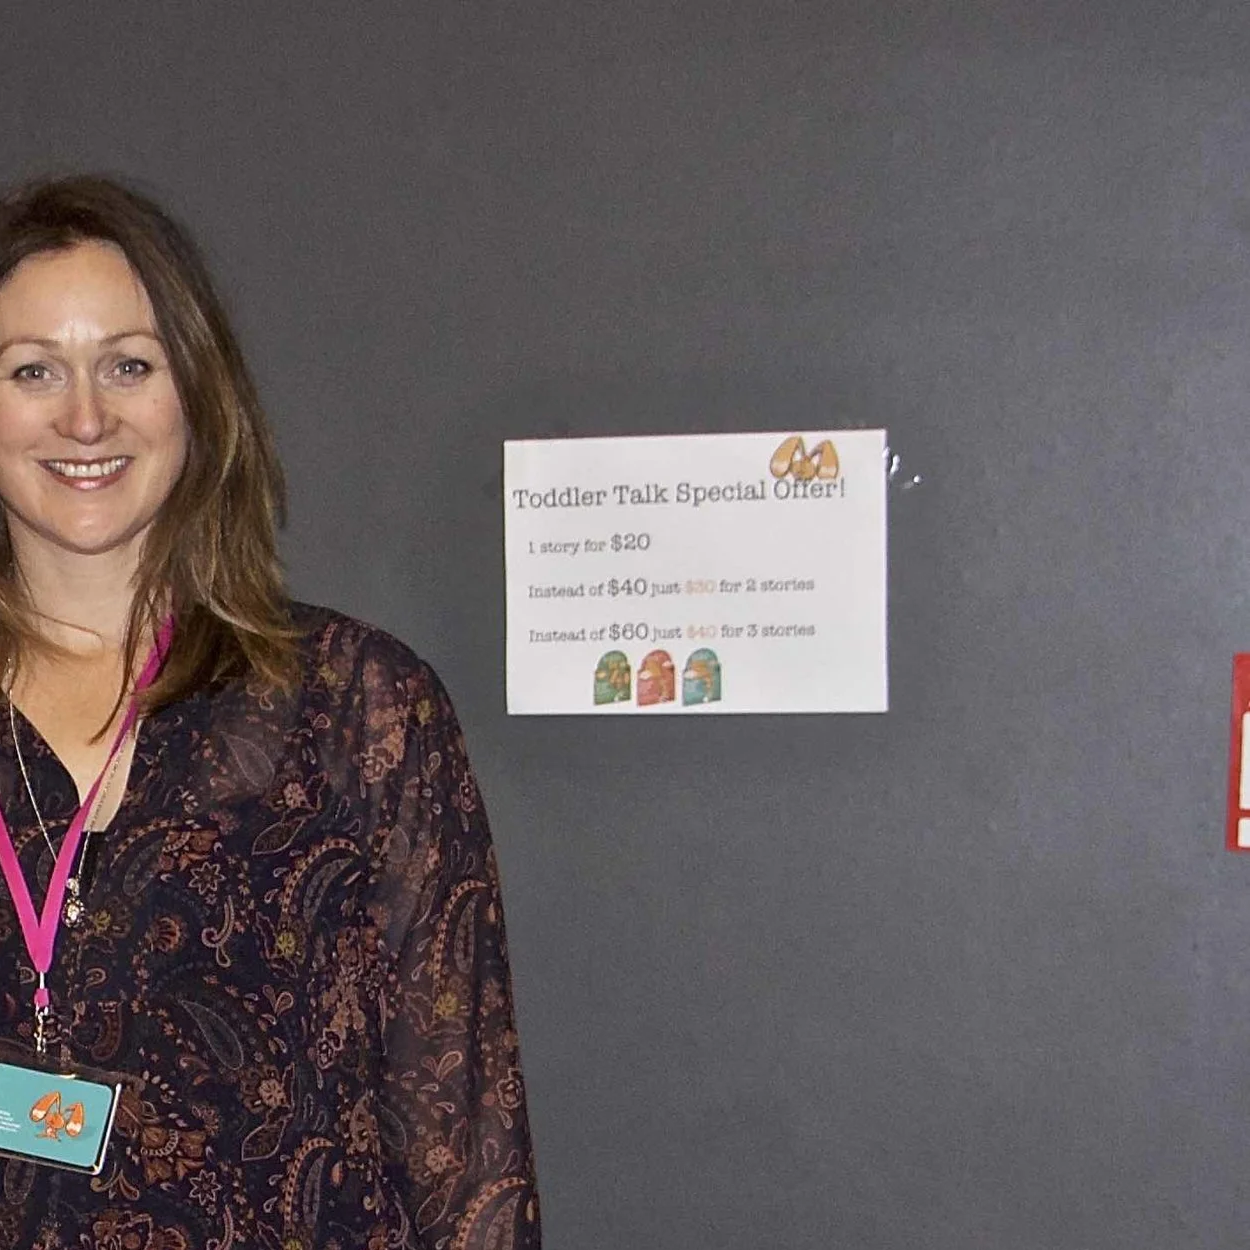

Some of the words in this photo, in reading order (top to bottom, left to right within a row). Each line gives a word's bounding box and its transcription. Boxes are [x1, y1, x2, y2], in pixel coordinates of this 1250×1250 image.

[513, 487, 607, 508] Toddler
[613, 484, 669, 504] Talk
[676, 480, 766, 507] Special
[773, 478, 845, 499] Offer!
[529, 541, 535, 553] 1
[540, 541, 580, 555] story
[584, 539, 607, 553] for
[611, 533, 651, 552] $20
[528, 583, 584, 598] Instead
[589, 582, 604, 597] of
[608, 578, 647, 597] $40
[650, 582, 681, 598] just
[720, 579, 741, 593] for
[746, 579, 756, 592] 2
[761, 578, 815, 592] stories
[529, 628, 586, 643] Instead
[590, 627, 606, 640] of
[608, 622, 649, 641] $60
[652, 627, 682, 643] just
[721, 624, 744, 638] for
[748, 624, 758, 638] 3
[761, 624, 817, 638] stories
